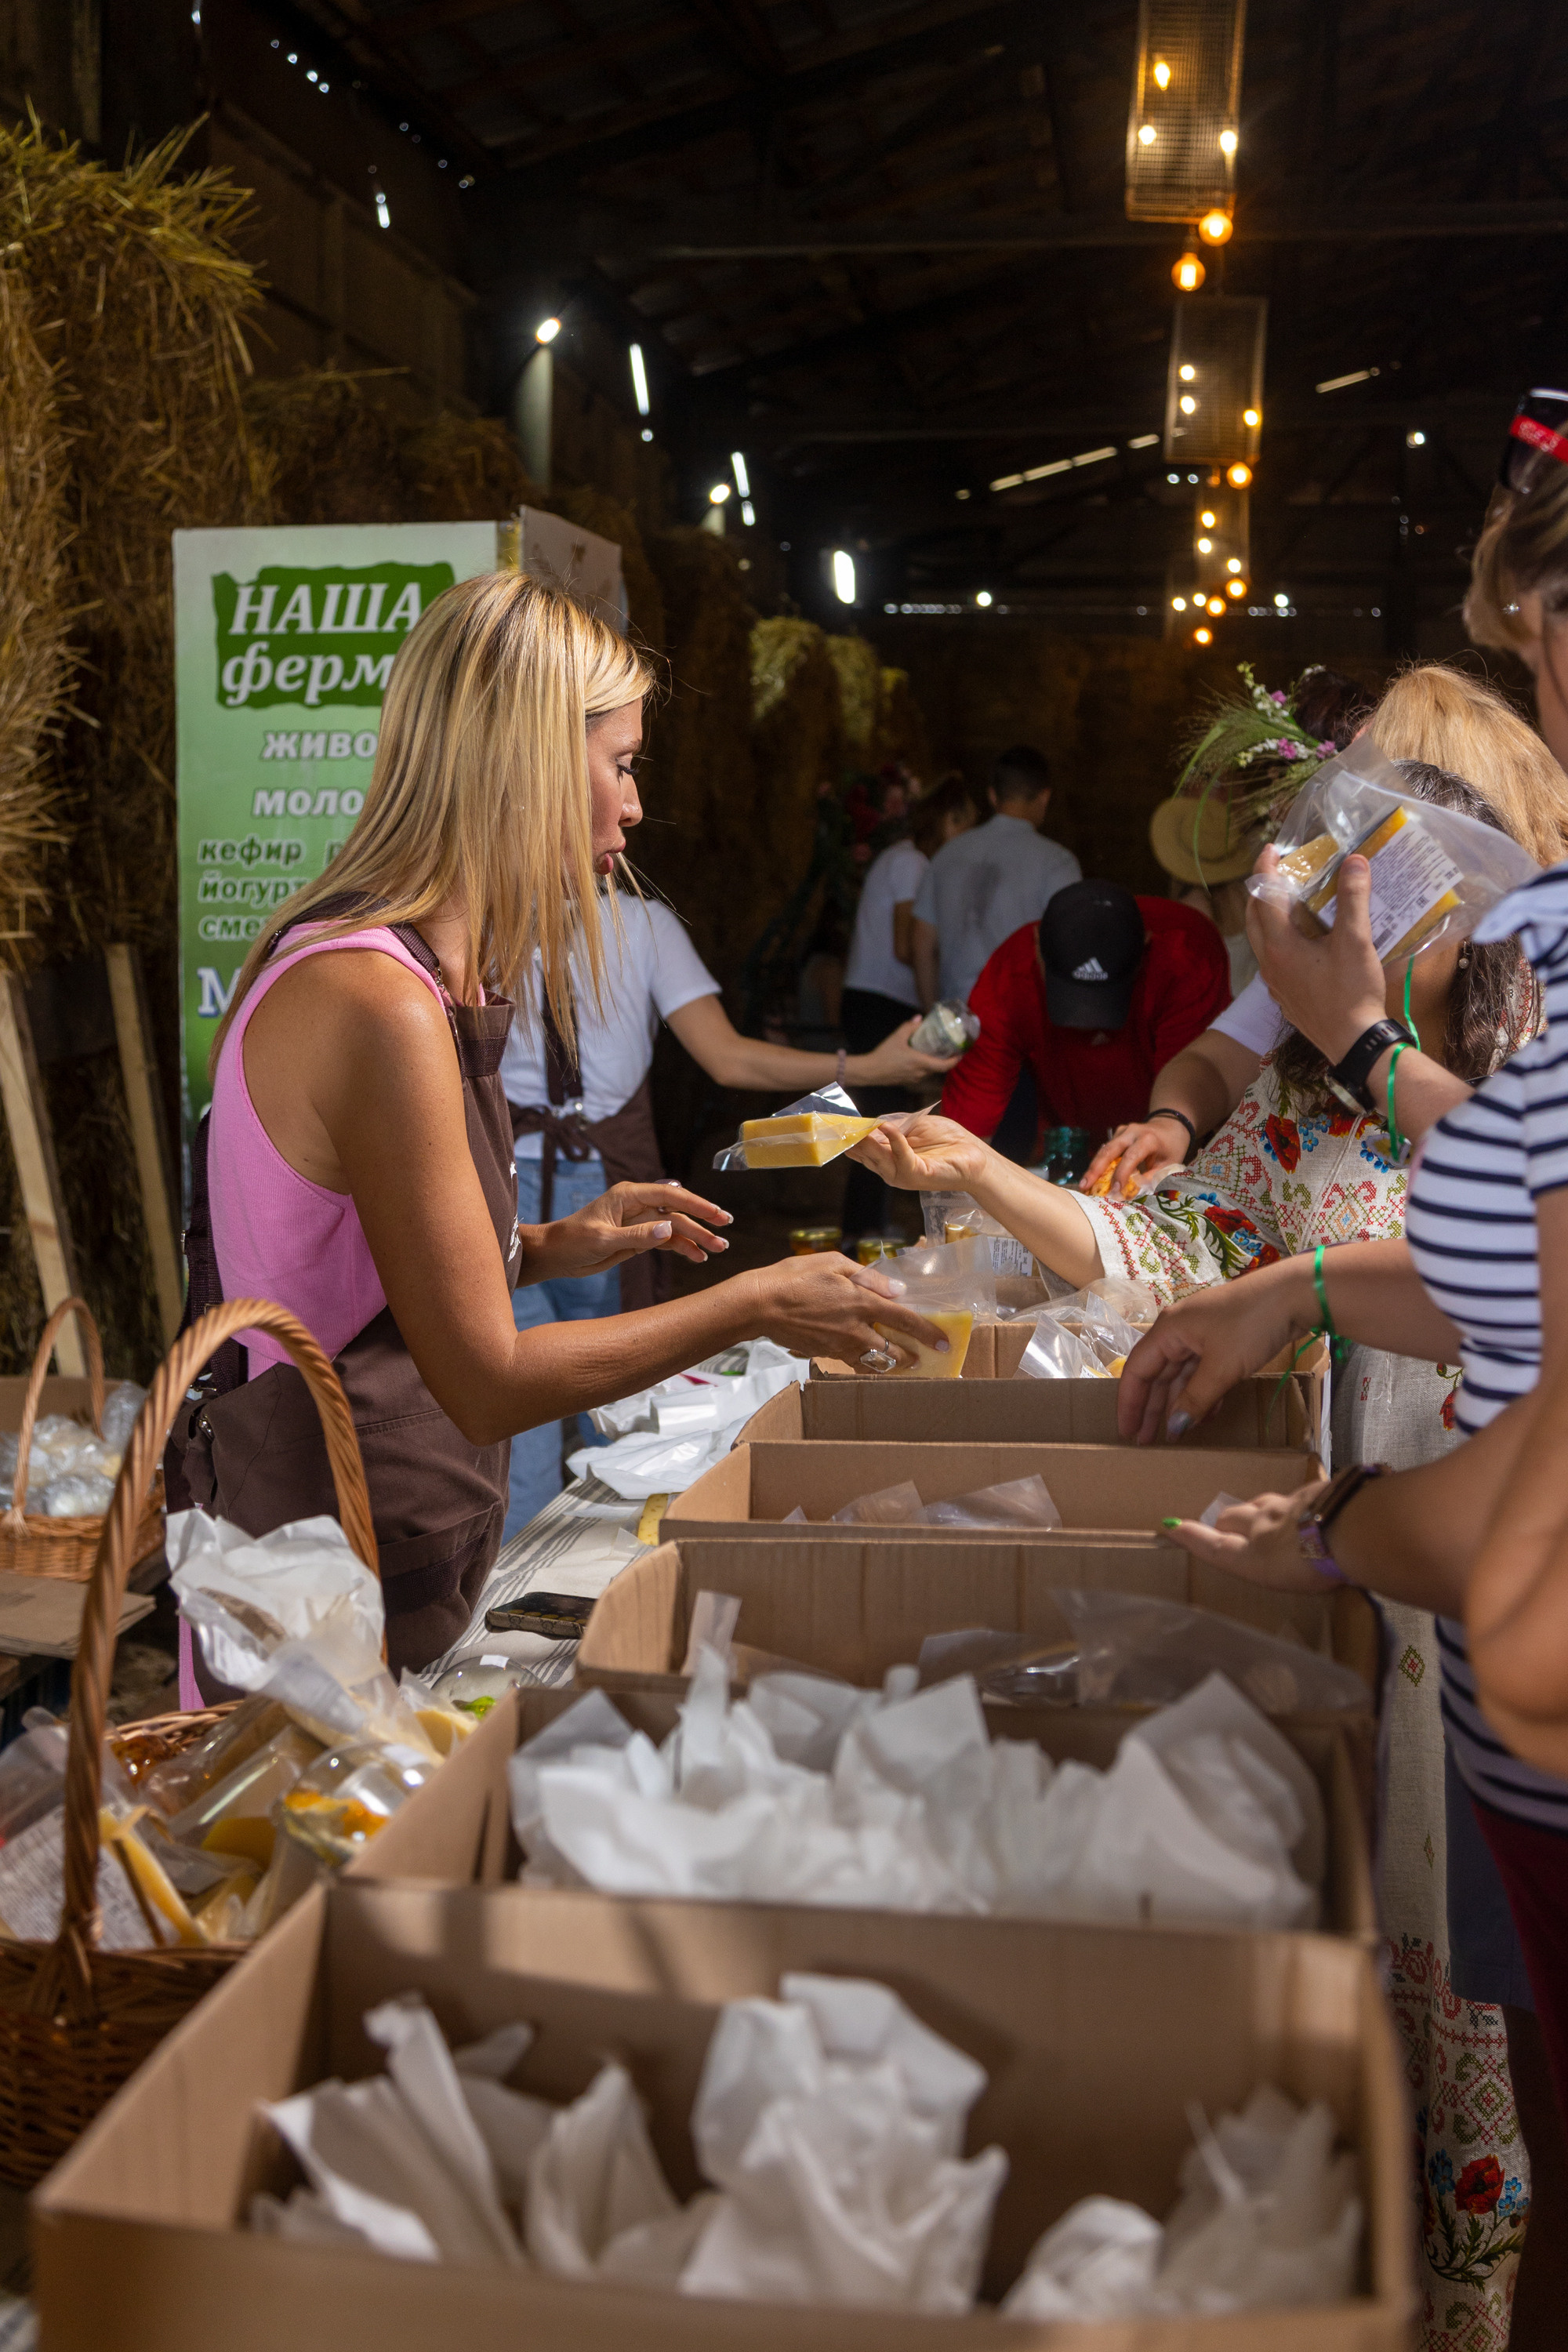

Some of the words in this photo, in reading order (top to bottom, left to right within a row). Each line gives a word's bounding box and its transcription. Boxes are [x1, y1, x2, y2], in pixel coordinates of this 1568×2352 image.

[229, 583, 422, 635] НАША
[221, 641, 395, 706] ферм
[199, 836, 303, 866] кефир
